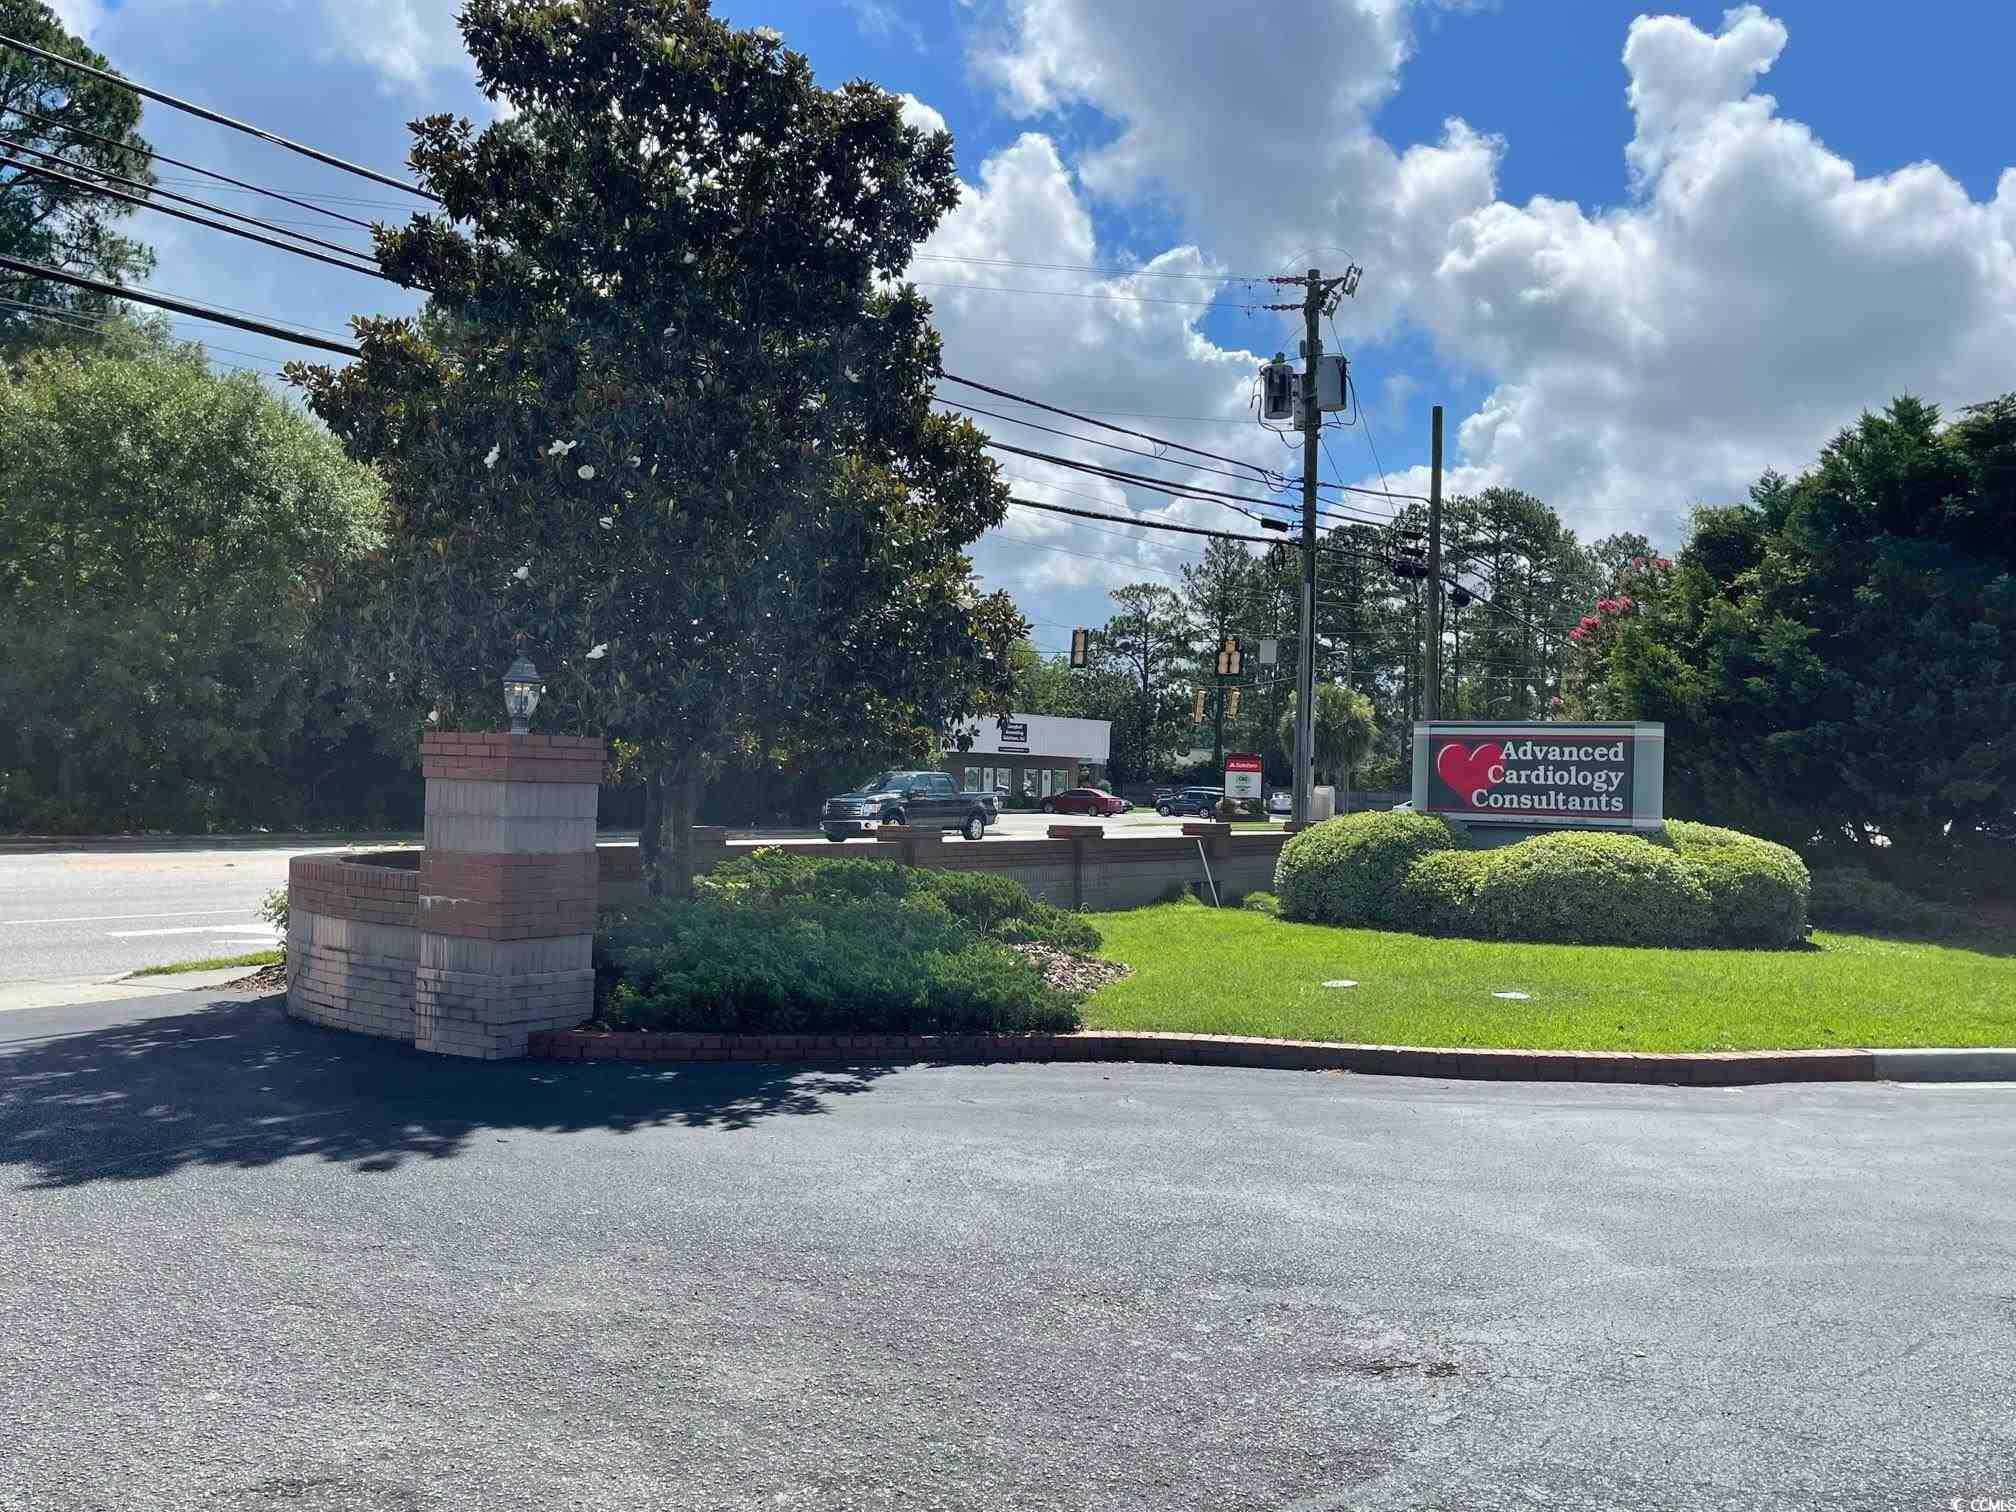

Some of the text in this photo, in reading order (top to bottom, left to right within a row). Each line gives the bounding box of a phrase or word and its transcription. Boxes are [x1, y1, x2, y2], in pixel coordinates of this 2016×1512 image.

[1499, 741, 1625, 762] Advanced
[1487, 765, 1625, 792] Cardiology
[1471, 788, 1625, 812] Consultants
